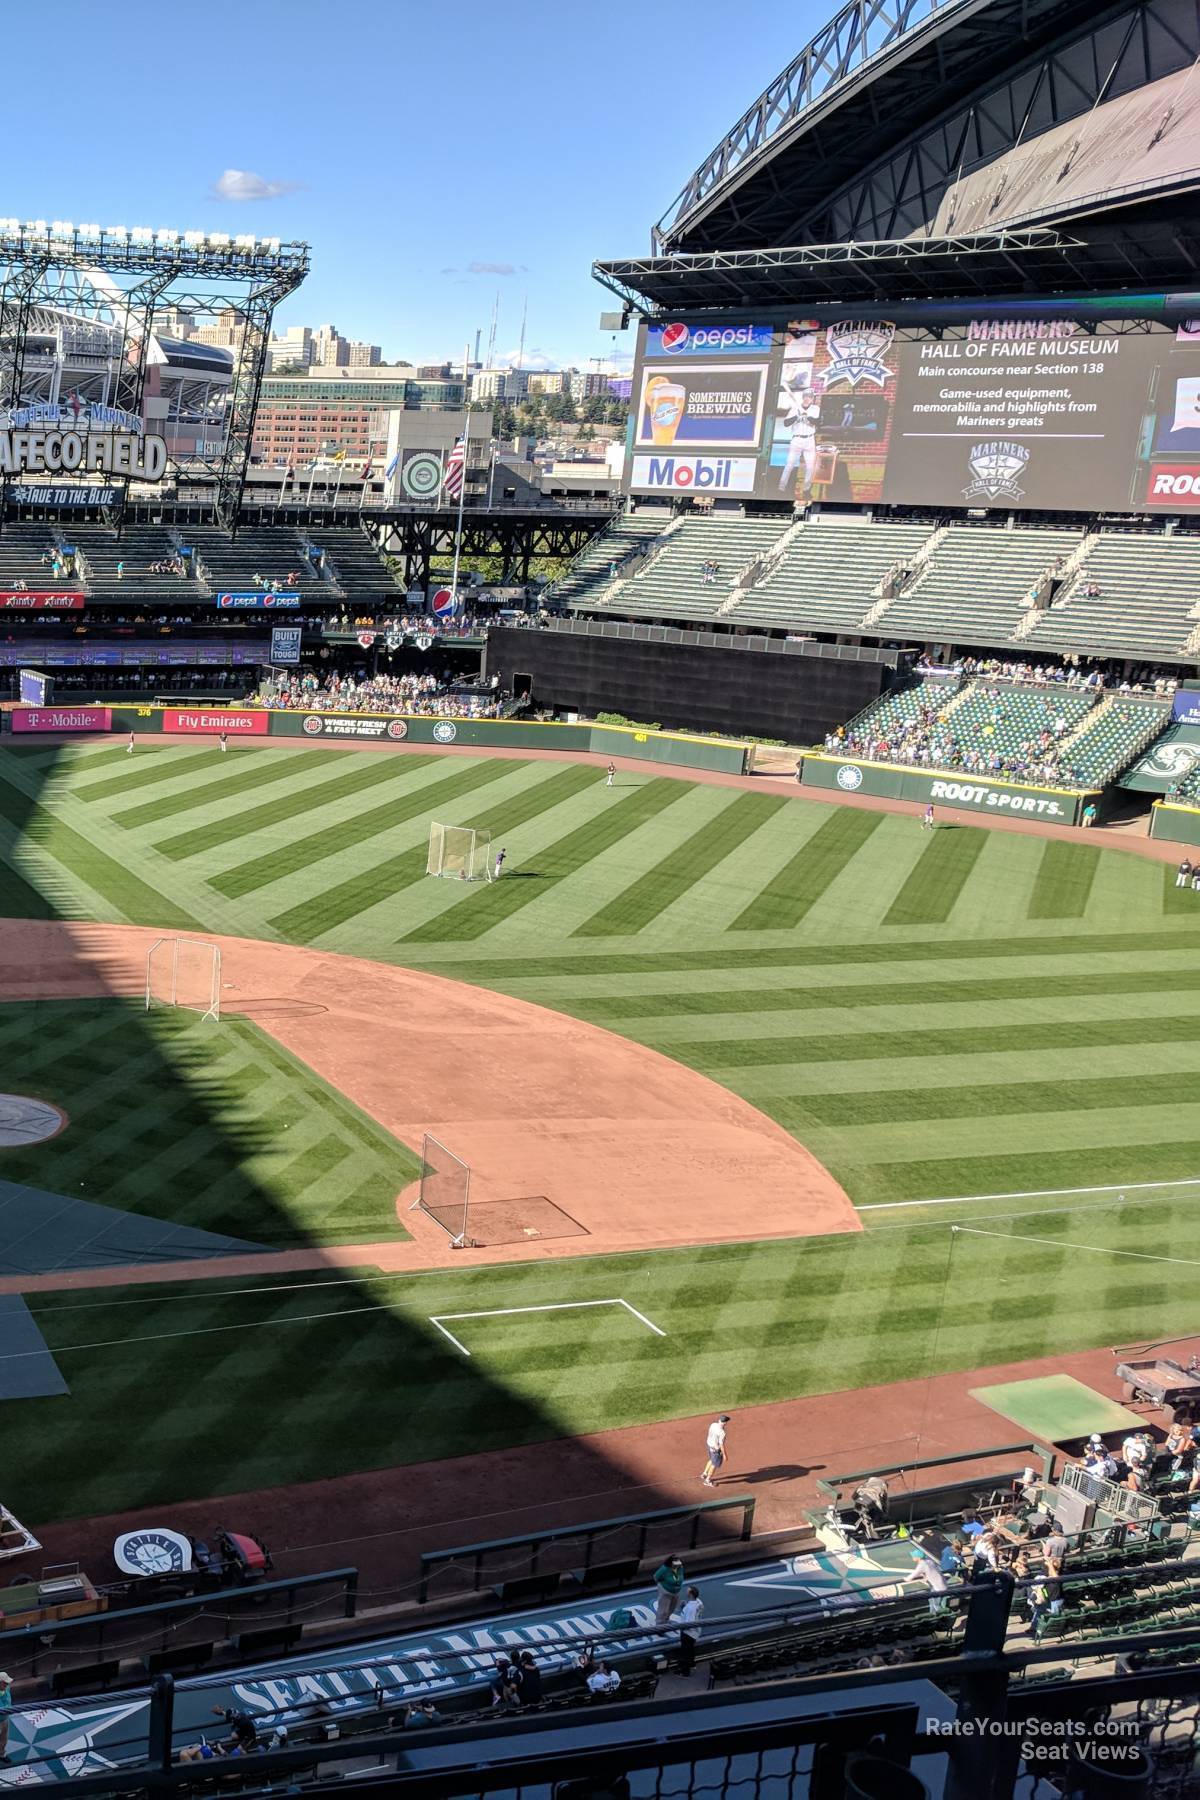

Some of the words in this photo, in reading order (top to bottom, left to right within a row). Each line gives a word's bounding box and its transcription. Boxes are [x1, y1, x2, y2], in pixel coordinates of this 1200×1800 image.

[692, 325, 755, 350] pepsi
[920, 344, 962, 359] HALL
[965, 343, 987, 357] OF
[990, 342, 1036, 357] FAME
[1039, 339, 1120, 355] MUSEUM
[918, 365, 945, 377] Main
[947, 366, 1004, 376] concourse
[1006, 366, 1033, 375] near
[1034, 362, 1079, 375] Section
[1082, 363, 1104, 373] 138
[689, 391, 752, 404] SOMETHING'S
[939, 388, 1003, 399] Game-used
[1004, 388, 1071, 401] equipment,
[912, 401, 981, 412] memorabilia
[983, 401, 1010, 412] and
[1009, 401, 1066, 414] highlights
[1068, 402, 1097, 411] from
[91, 401, 142, 431] MARINERS
[956, 416, 1006, 426] Mariners
[1007, 417, 1044, 429] greats
[86, 434, 168, 481] FIELD
[969, 441, 1031, 461] MARINERS
[648, 459, 730, 488] Mobil
[27, 487, 53, 504] TRUE
[55, 490, 68, 504] TO
[70, 490, 88, 504] THE
[90, 488, 115, 505] BLUE
[6, 596, 36, 607] xfinity
[44, 596, 74, 607] xfinity
[234, 597, 257, 606] pepsi
[276, 597, 299, 606] pepsi
[274, 632, 298, 641] BUILT
[361, 636, 372, 645] 42
[390, 637, 400, 645] 24
[273, 650, 297, 659] TOUGH
[137, 708, 152, 717] 376
[179, 714, 198, 729] Fly
[200, 716, 253, 728] Emirates
[324, 719, 356, 727] WHERE
[357, 721, 387, 729] FRESH
[333, 726, 356, 734] FAST
[930, 781, 988, 803] ROOT
[986, 793, 1060, 815] SPORTS
[232, 1644, 456, 1725] SEATTLE
